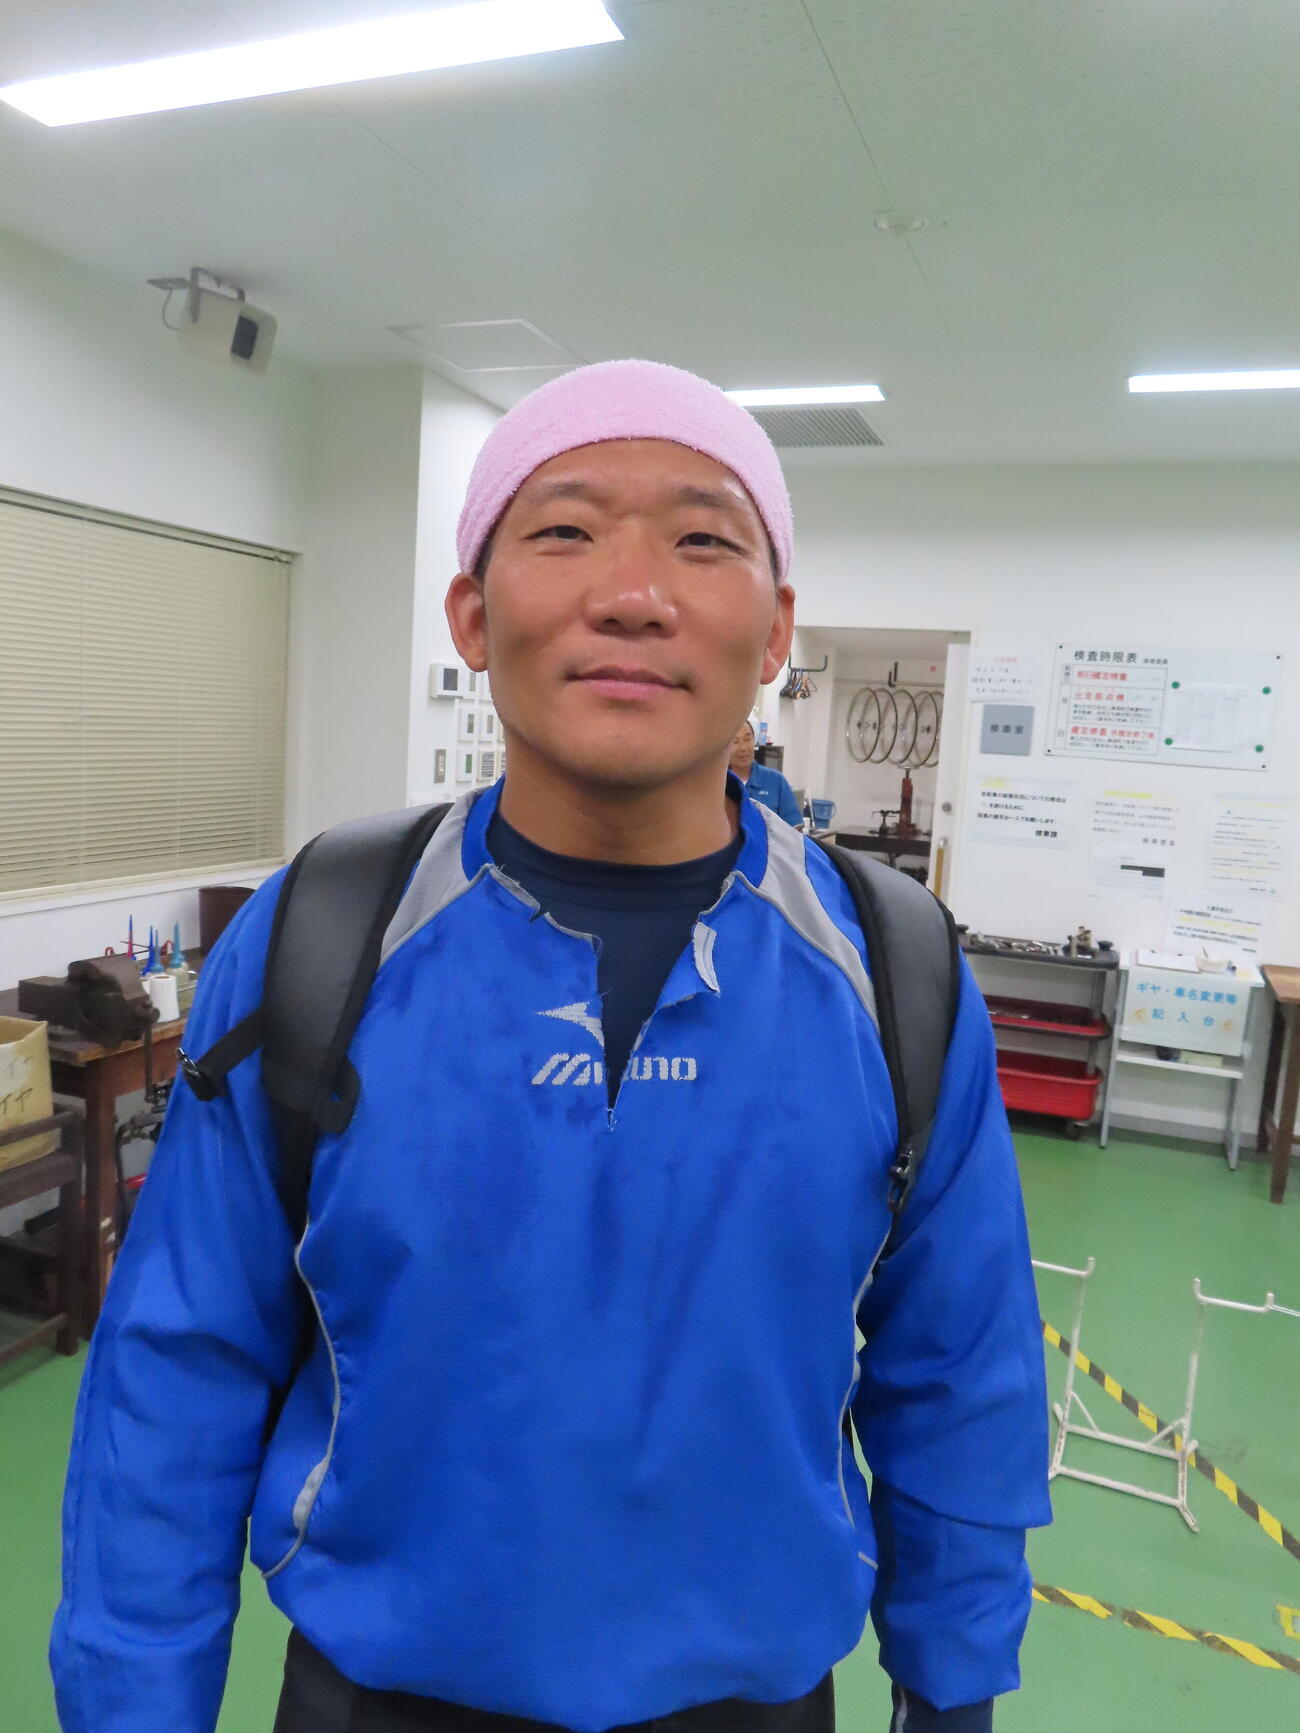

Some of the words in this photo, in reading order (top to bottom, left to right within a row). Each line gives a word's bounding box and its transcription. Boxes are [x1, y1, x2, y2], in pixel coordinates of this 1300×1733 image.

[1074, 650, 1137, 664] 検査時限表
[1151, 1008, 1215, 1028] 記入台
[531, 1053, 698, 1086] MIUNO
